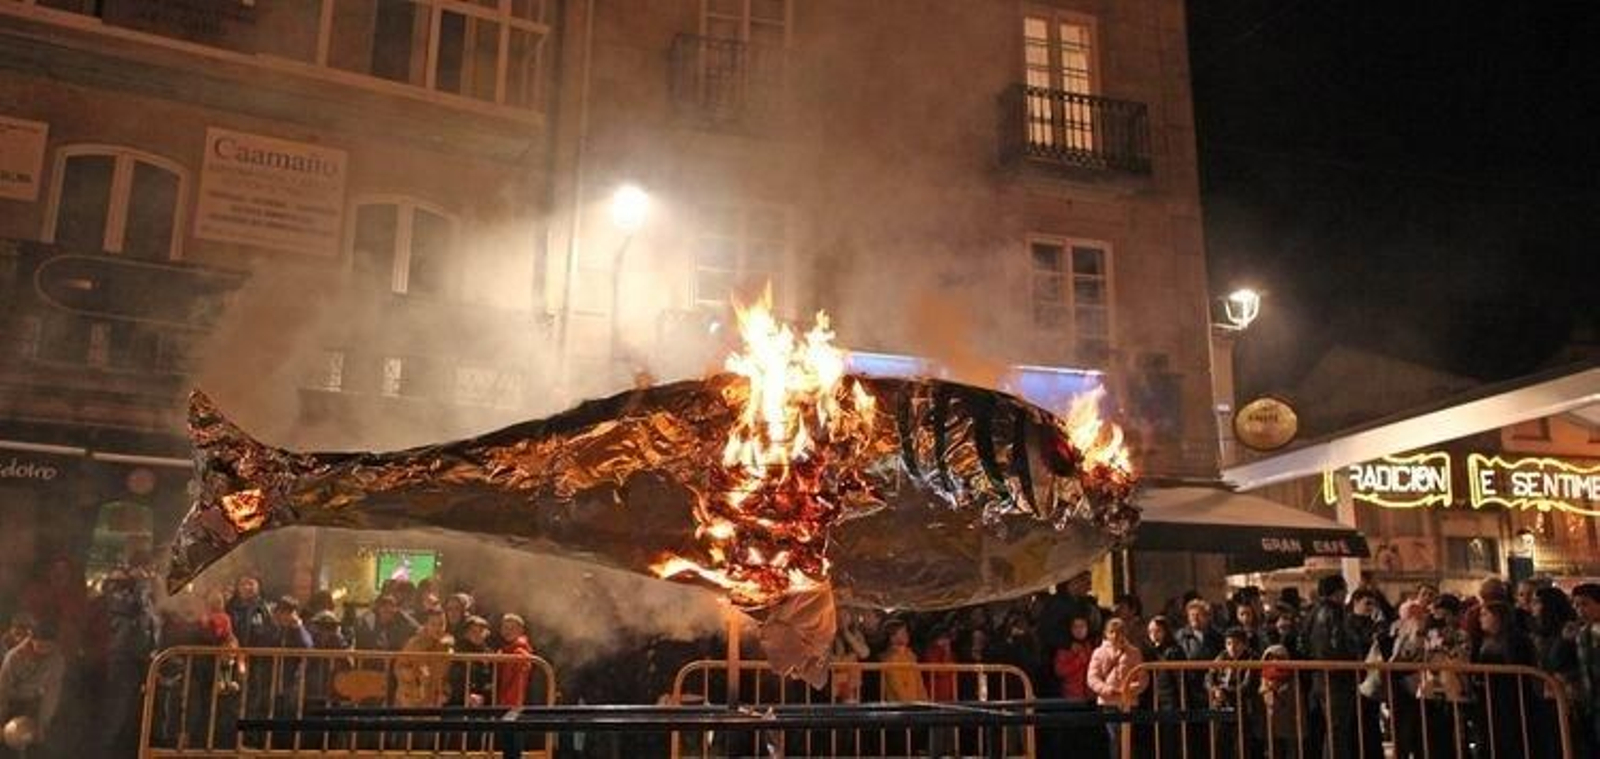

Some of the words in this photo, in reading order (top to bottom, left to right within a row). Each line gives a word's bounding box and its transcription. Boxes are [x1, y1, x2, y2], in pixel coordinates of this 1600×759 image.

[213, 135, 338, 176] Caamaño
[1480, 470, 1496, 495] E
[1262, 537, 1302, 553] GRAN
